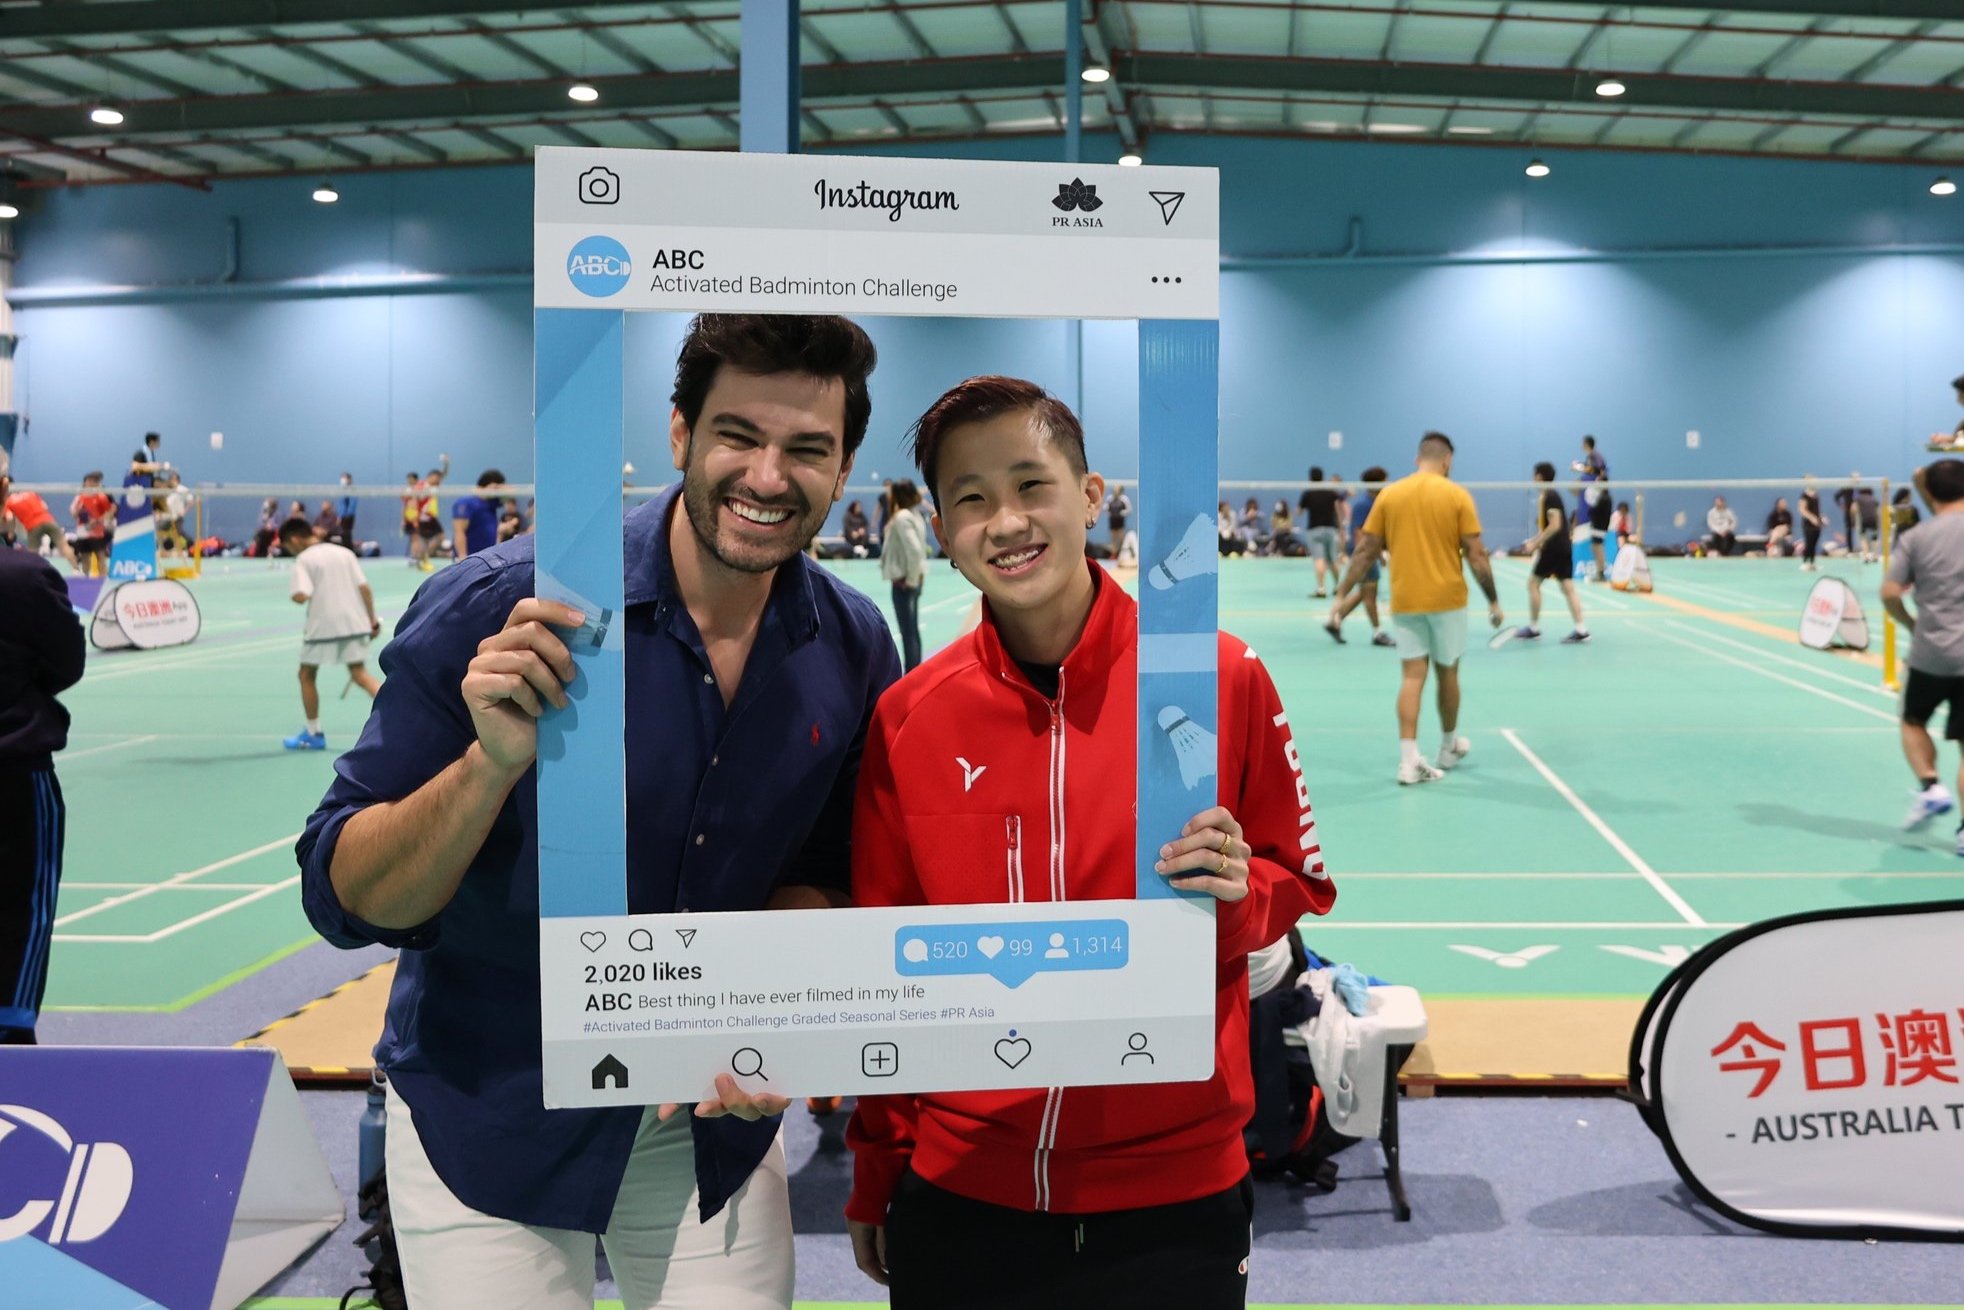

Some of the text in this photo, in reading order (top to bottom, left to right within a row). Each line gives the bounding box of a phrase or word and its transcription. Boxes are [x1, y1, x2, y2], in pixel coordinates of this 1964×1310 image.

[814, 179, 960, 222] Instagram
[1052, 216, 1103, 228] PR ASIA
[652, 249, 704, 270] ABC
[650, 275, 957, 301] Activated Badminton Challenge
[932, 936, 1122, 959] 520 99 1,314
[584, 961, 703, 985] 2,020 likes
[585, 993, 633, 1012] ABC
[639, 994, 673, 1008] Best
[677, 993, 716, 1009] thing
[730, 991, 766, 1005] have
[769, 991, 802, 1003] ever
[806, 986, 853, 1002] filmed
[858, 987, 871, 1001] in
[875, 988, 899, 1004] my
[903, 984, 926, 999] life
[584, 1006, 995, 1033] #Activated Badminton Challenge Graded Seasonal Series #PR Asia
[1711, 1008, 1964, 1098] 今日澳
[1752, 1105, 1938, 1144] AUSTRALIA
